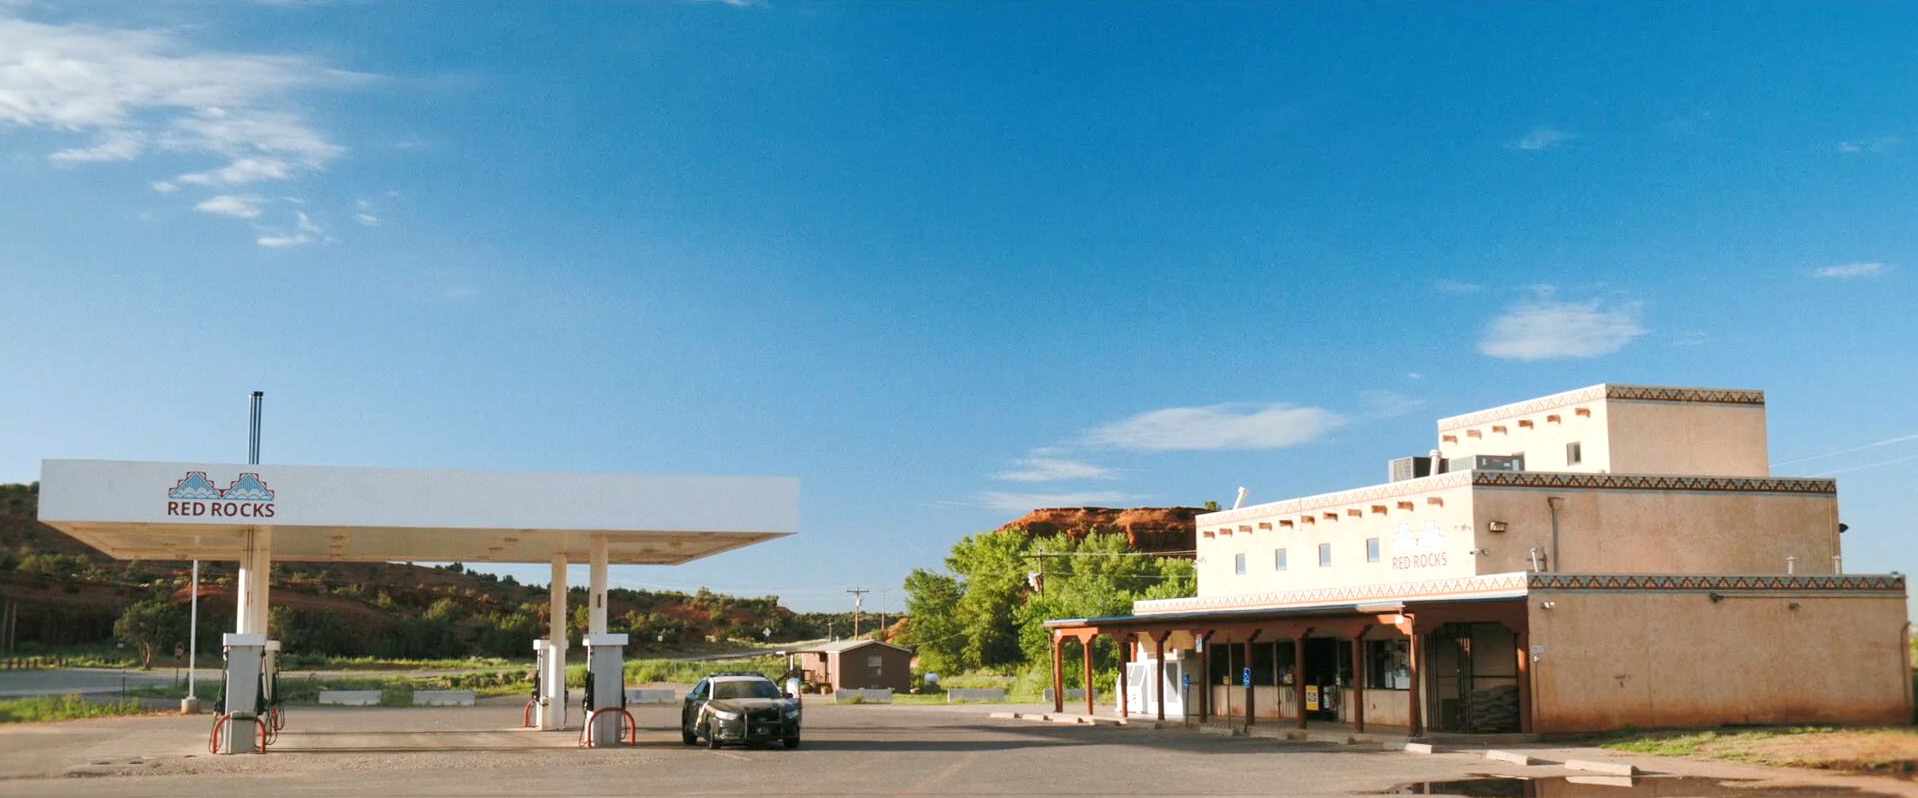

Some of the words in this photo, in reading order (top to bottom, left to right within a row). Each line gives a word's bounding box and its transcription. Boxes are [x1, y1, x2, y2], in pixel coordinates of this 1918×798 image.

[167, 501, 205, 516] RED
[211, 502, 275, 517] ROCKS
[1392, 556, 1411, 570] RED
[1413, 552, 1448, 569] ROCKS
